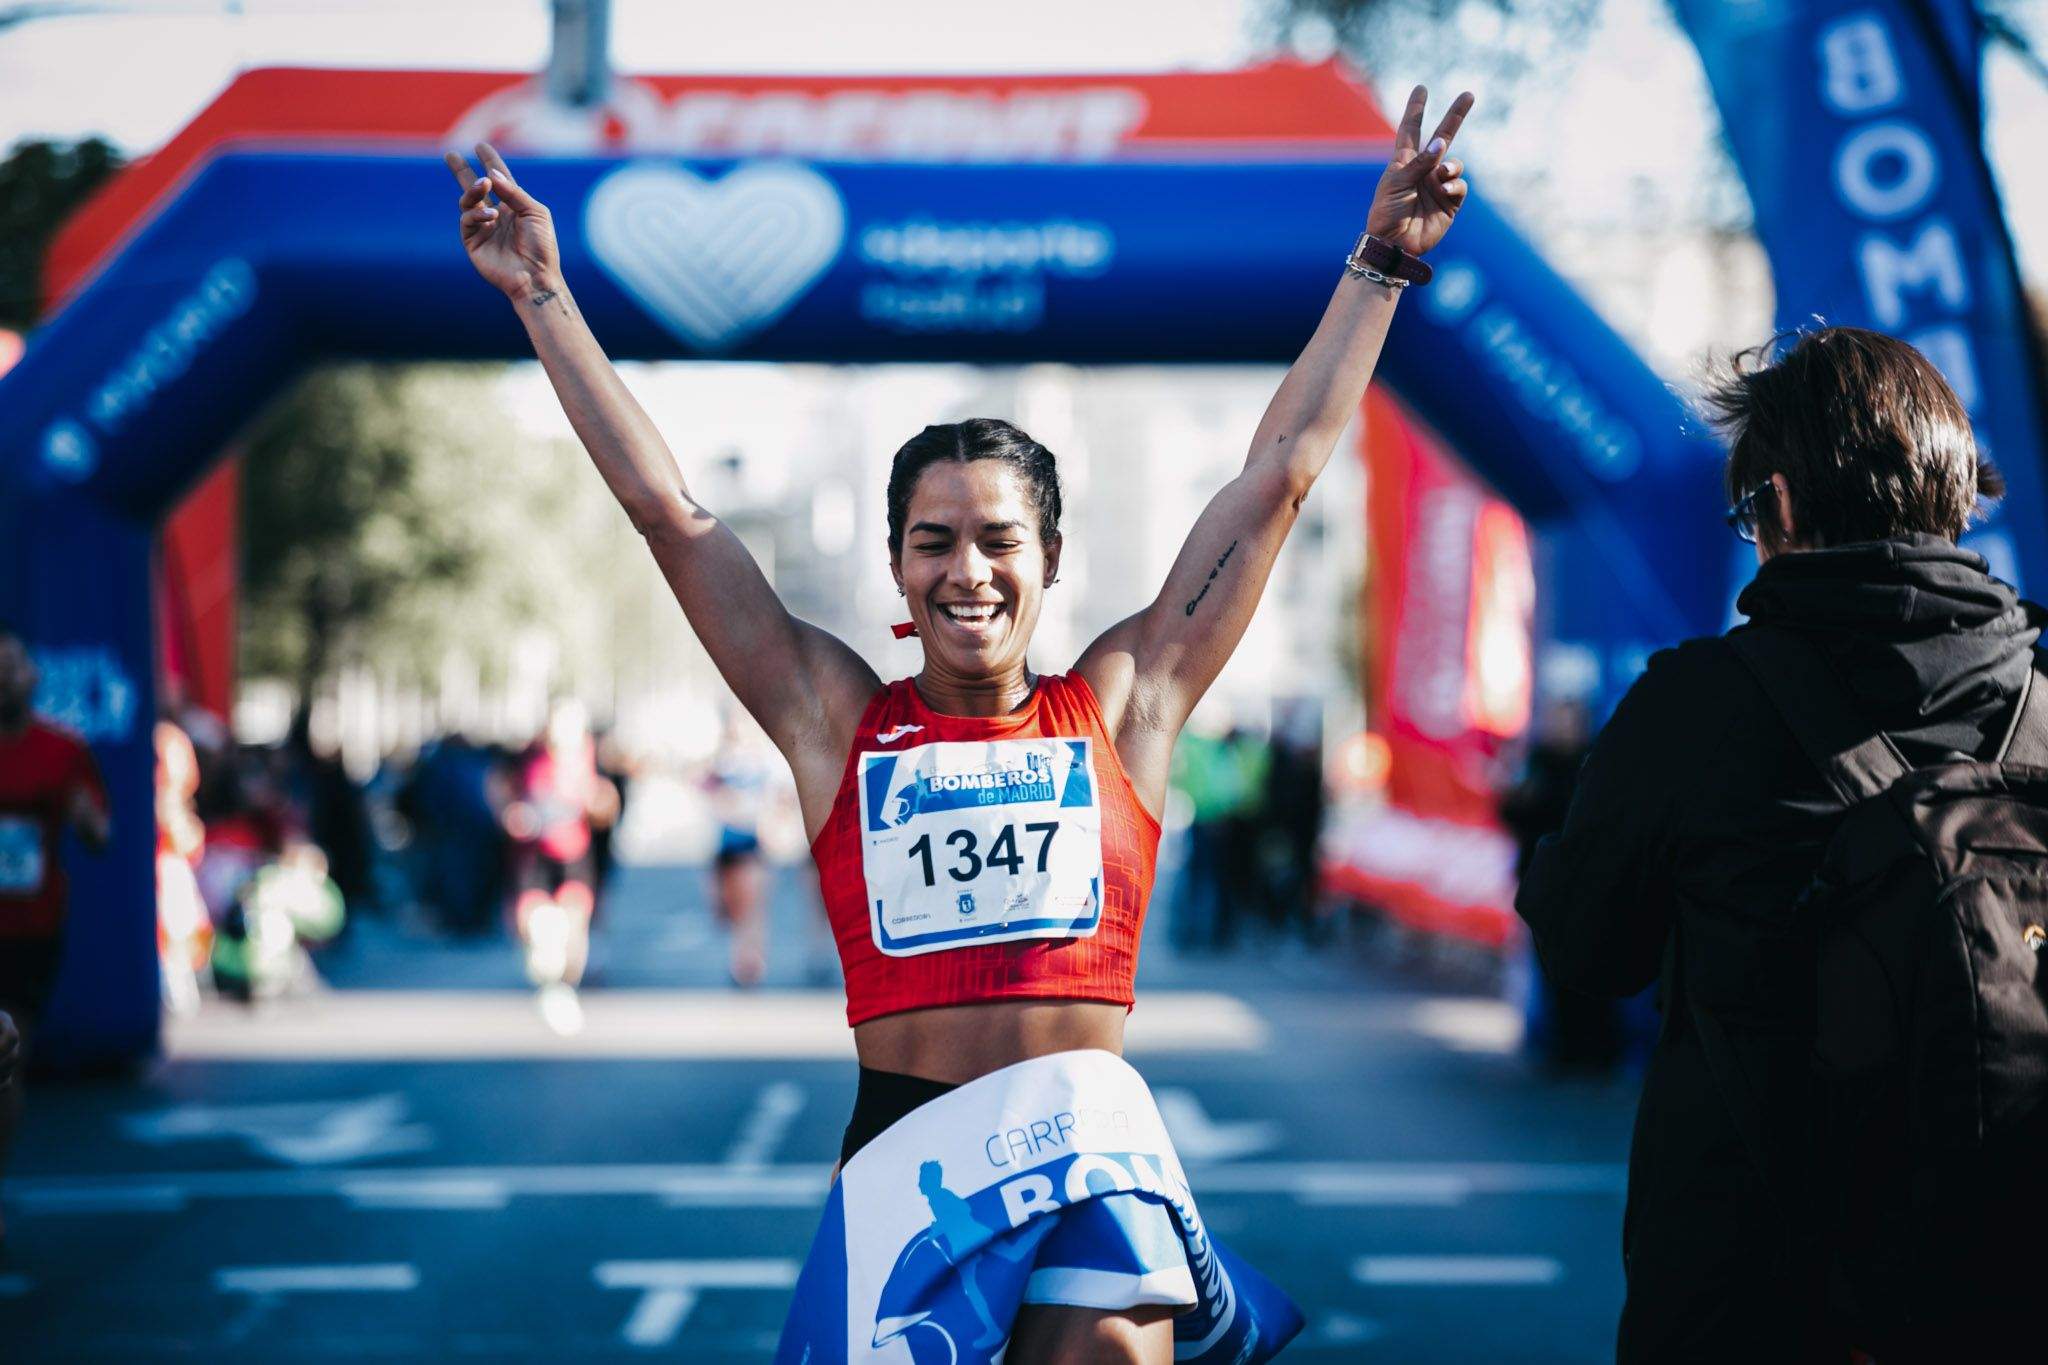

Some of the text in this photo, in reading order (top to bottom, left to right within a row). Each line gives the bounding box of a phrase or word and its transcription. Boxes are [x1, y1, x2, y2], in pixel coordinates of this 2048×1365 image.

[929, 769, 1051, 793] BOMBEROS
[978, 783, 1053, 804] de MADRID
[908, 821, 1060, 887] 1347
